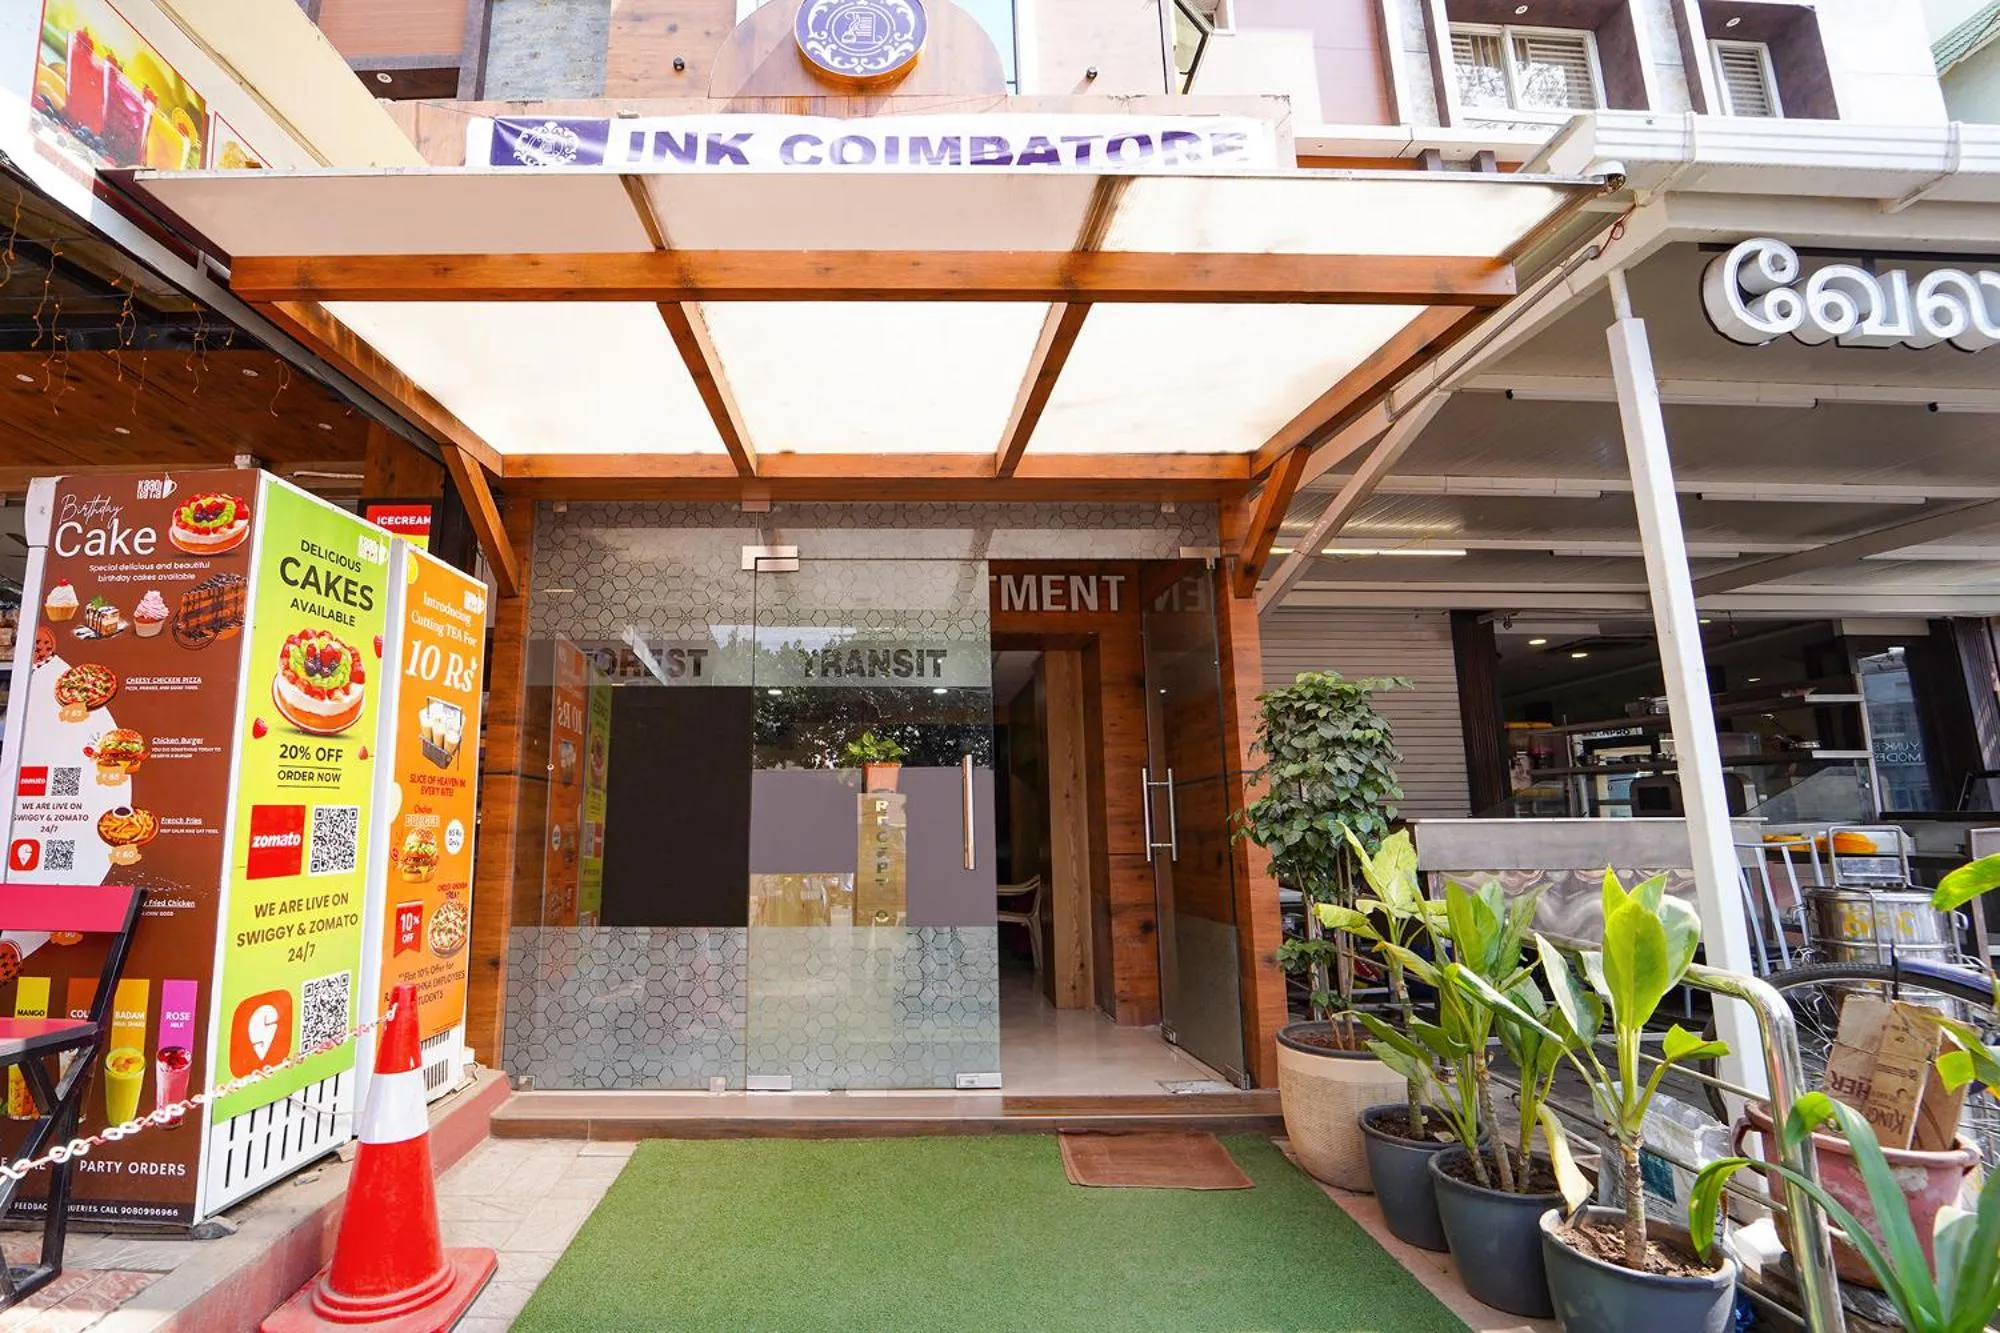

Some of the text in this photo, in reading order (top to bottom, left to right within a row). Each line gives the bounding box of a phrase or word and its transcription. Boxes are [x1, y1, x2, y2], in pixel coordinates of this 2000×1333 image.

[626, 130, 1248, 166] INK COIMBATORE
[60, 493, 123, 529] Birthday
[55, 518, 157, 557] Cake
[301, 540, 362, 573] DELICIOUS
[89, 560, 210, 574] Special delicious and beautiful
[98, 574, 130, 583] birthday
[158, 573, 196, 581] available
[279, 556, 374, 612] CAKES
[989, 575, 1125, 611] MENT
[290, 598, 356, 628] AVAILABLE
[423, 591, 471, 627] Introducing
[411, 609, 445, 637] Cutting
[446, 624, 463, 642] TEA
[405, 640, 441, 681] 10
[152, 676, 181, 685] CHICKEN
[183, 676, 202, 685] PIZZA
[152, 737, 204, 746] Chicken Burger
[279, 744, 343, 763] 20% OFF
[278, 771, 342, 783] ORDER NOW
[54, 814, 89, 822] ZOMATO
[161, 817, 202, 825] French Fries
[40, 825, 58, 834] 24/7
[252, 833, 302, 849] zomato
[167, 900, 196, 908] Chicken
[254, 892, 349, 918] WE ARE LIVE ON
[236, 913, 359, 948] SWIGGY & ZOMATO
[287, 942, 316, 964] 24/7
[17, 1009, 45, 1017] MANGO
[70, 1009, 90, 1019] COL
[114, 1011, 145, 1020] BADAM
[166, 1012, 191, 1021] ROSE
[80, 1160, 186, 1177] PARTY ORDERS
[14, 1201, 48, 1211] FEEDBAC
[67, 1204, 98, 1213] UERIES
[100, 1205, 118, 1214] CALL
